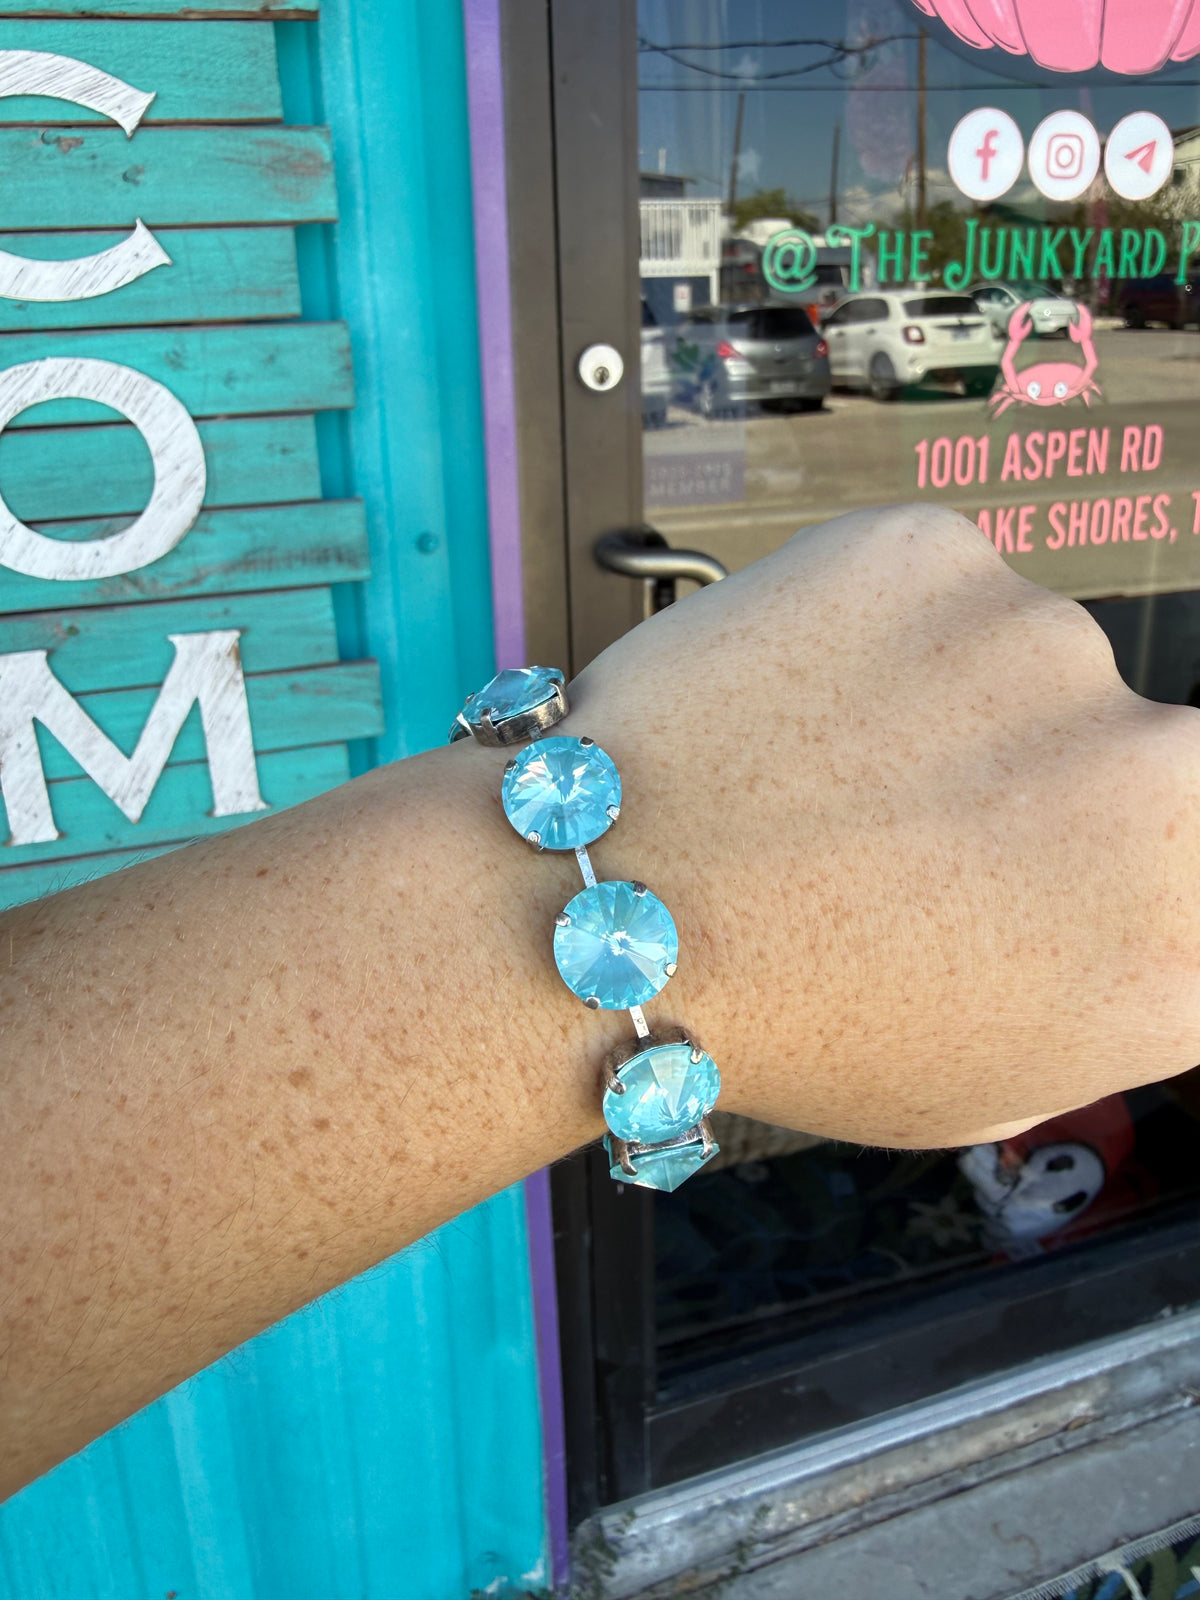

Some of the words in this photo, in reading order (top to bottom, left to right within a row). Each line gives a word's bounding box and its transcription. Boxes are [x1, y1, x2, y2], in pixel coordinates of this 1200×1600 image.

[943, 218, 1167, 292] JUNKYARD
[914, 435, 990, 489] 1001
[1000, 427, 1111, 482] ASPEN
[1120, 424, 1164, 473] RD
[959, 505, 1037, 554] AKE
[1046, 493, 1178, 549] SHORES,
